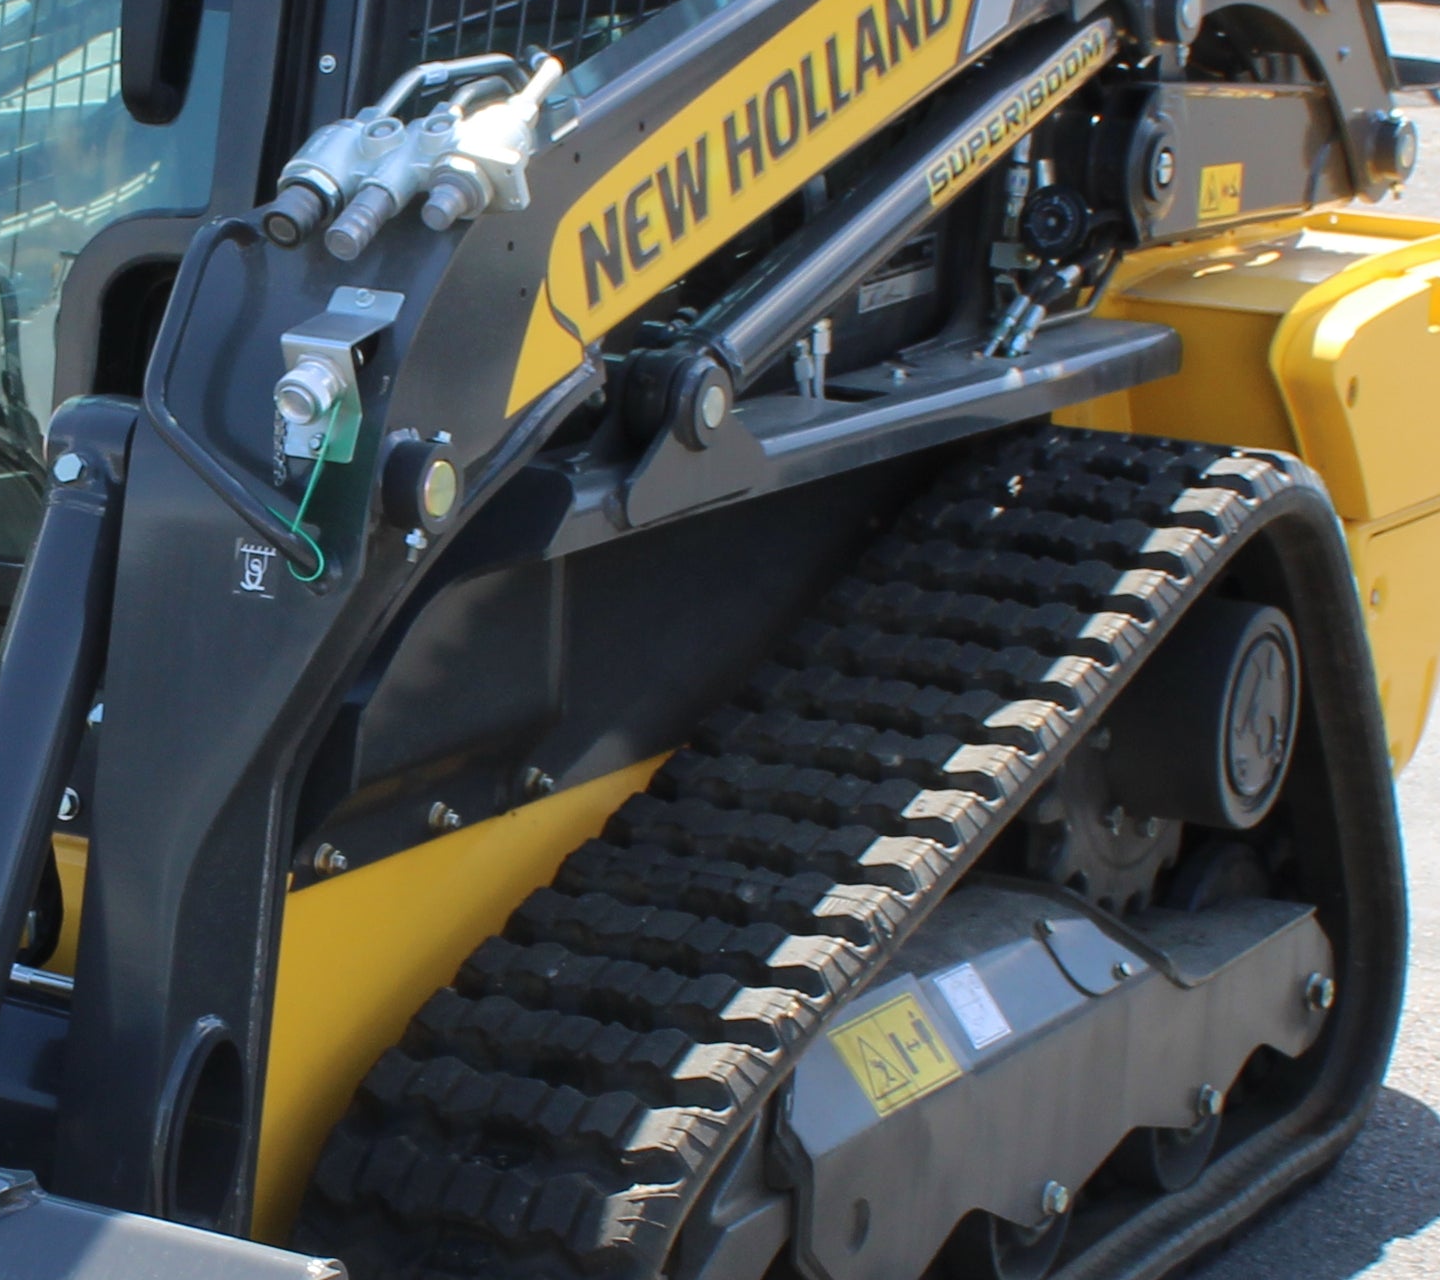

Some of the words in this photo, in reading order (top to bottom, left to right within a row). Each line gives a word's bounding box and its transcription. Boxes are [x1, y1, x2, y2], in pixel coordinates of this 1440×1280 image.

[927, 100, 1021, 196] SUPER
[1027, 28, 1105, 112] BOOM
[577, 131, 709, 311] NEW
